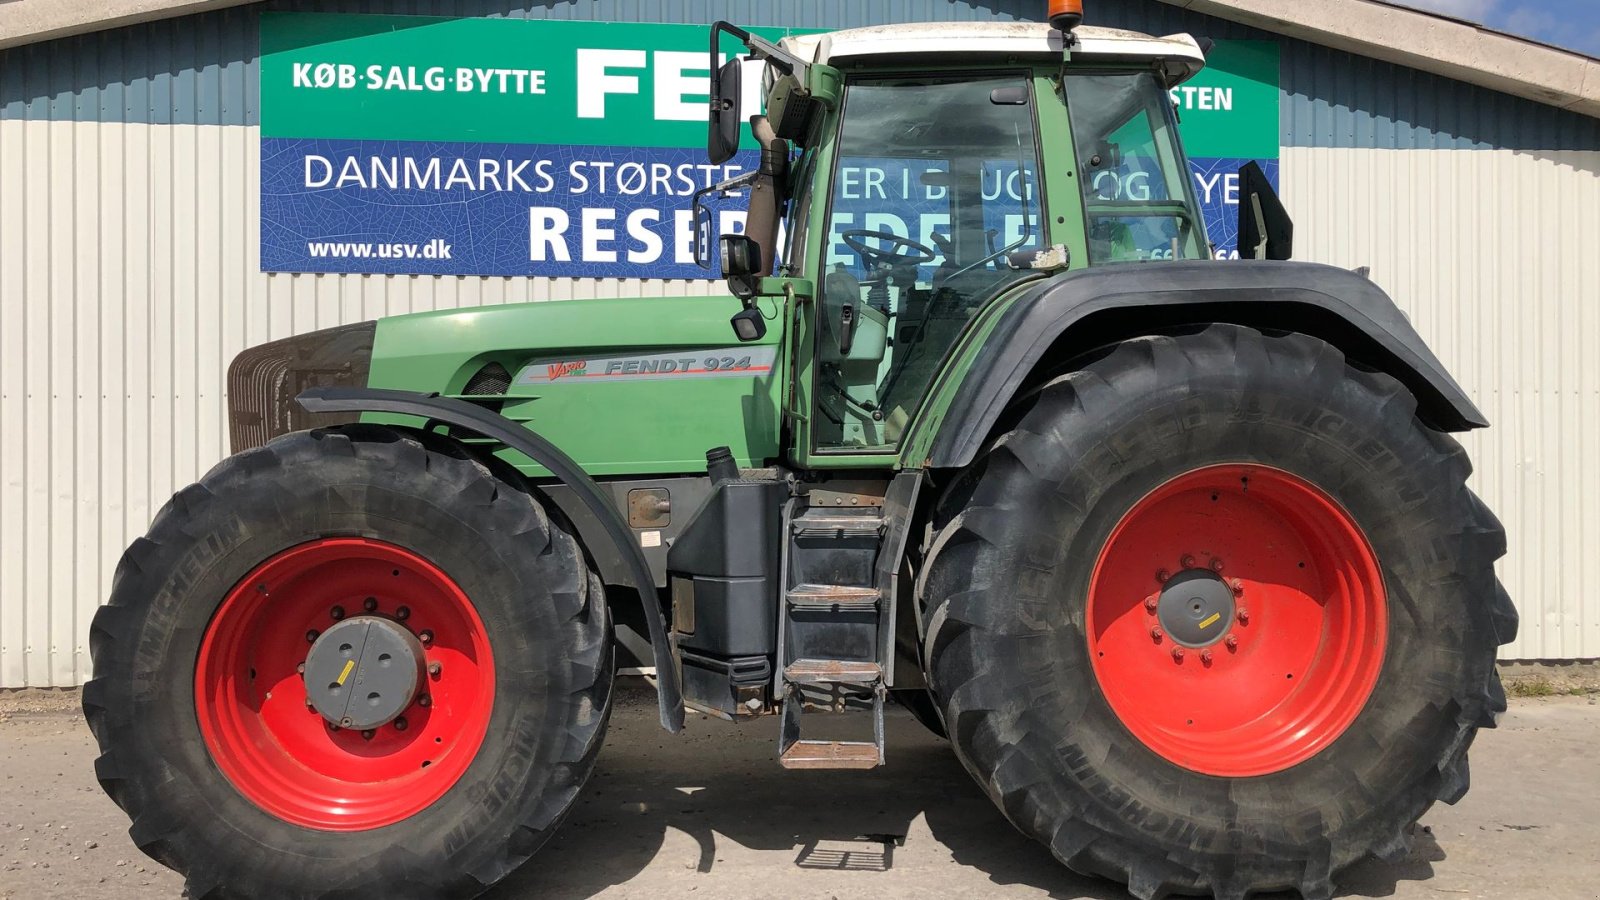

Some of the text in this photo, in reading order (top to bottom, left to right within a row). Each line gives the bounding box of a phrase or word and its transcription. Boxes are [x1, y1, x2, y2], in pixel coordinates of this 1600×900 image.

[304, 154, 555, 193] DANMARKS
[569, 159, 742, 197] STØRSTE
[841, 167, 887, 199] ER
[903, 168, 909, 199] I
[1194, 172, 1240, 204] YE
[307, 239, 453, 259] www.usv.dk
[604, 355, 752, 375] FENDT 924
